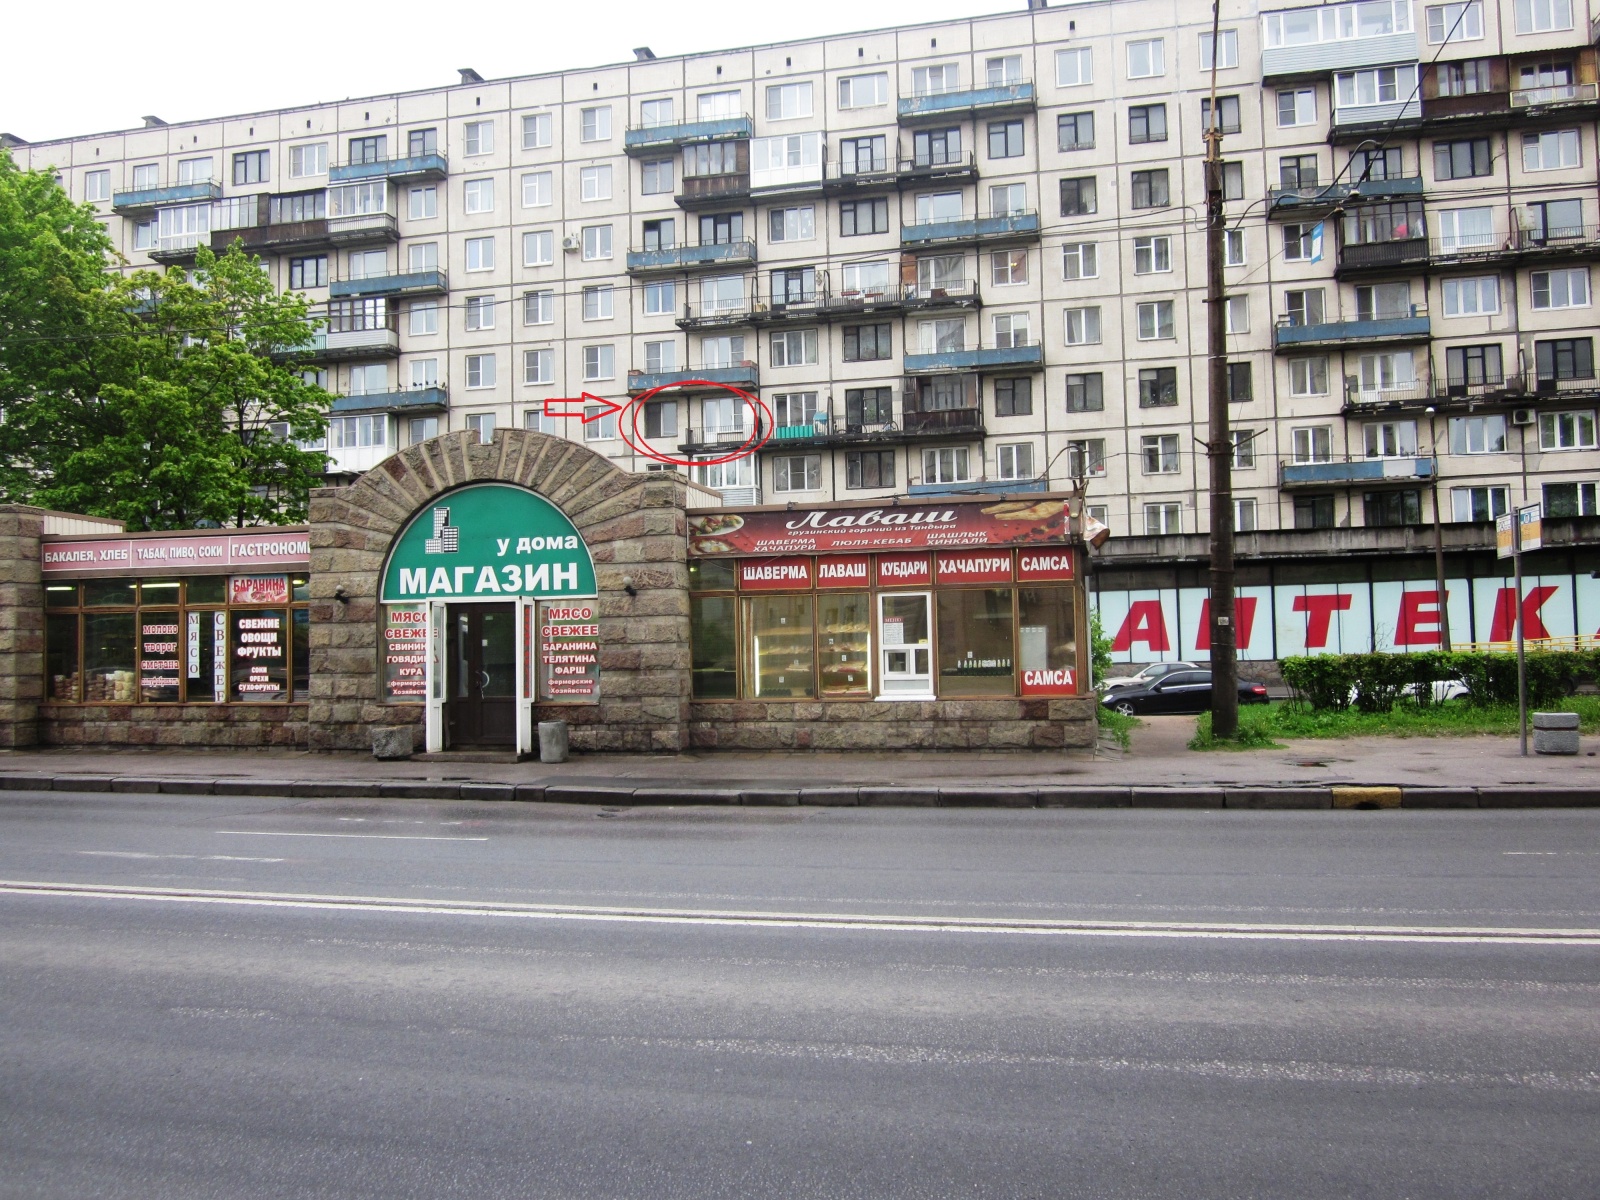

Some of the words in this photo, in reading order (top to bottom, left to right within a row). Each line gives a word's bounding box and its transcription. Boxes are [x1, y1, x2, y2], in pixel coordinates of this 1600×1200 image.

[785, 509, 958, 530] Лаваш
[788, 527, 847, 536] грузинский
[849, 526, 892, 534] горячий
[909, 523, 956, 531] Тандыра
[926, 531, 988, 539] ШАШЛЫК
[497, 537, 510, 556] у
[516, 535, 578, 554] дома
[753, 544, 817, 552] ХАЧАПУРИ
[756, 538, 816, 546] ШАВЕРМА
[831, 537, 912, 547] ЛЮЛЯ-КЕБАБ
[926, 537, 988, 546] ХИНКАЛИ
[45, 551, 96, 563] БАКАЛЕЯ,
[99, 550, 128, 561] ХЛЕБ
[137, 548, 168, 561] ТАБАК,
[169, 546, 196, 560] ПИВО,
[199, 545, 223, 558] СОКИ
[818, 563, 866, 578] ЛАВАШ
[881, 561, 928, 578] КУБДАРИ
[938, 558, 1010, 574] ХАЧАПУРИ
[1021, 556, 1069, 572] САМСА
[400, 562, 578, 595] МАГАЗИН
[744, 566, 808, 580] ШАВЕРМА
[234, 578, 286, 592] БАРАНИНА
[549, 607, 592, 620] МЯСО
[1111, 586, 1600, 652] АПТЕК
[142, 624, 178, 635] молоко
[239, 618, 280, 629] СВЕЖИЕ
[542, 624, 599, 637] СВЕЖЕЕ
[189, 615, 199, 674] МЯСО
[240, 632, 278, 644] ОВОЩИ
[144, 642, 177, 654] творог
[238, 646, 282, 658] ФРУКТЫ
[388, 643, 436, 651] СВИНИН
[542, 642, 598, 651] БАРАНИНА
[542, 654, 596, 664] ТЕЛЯТИНА
[251, 666, 268, 674] СОКИ
[400, 668, 424, 676] КУРА
[554, 666, 586, 675] ФАРШ
[1024, 670, 1072, 686] САМСА
